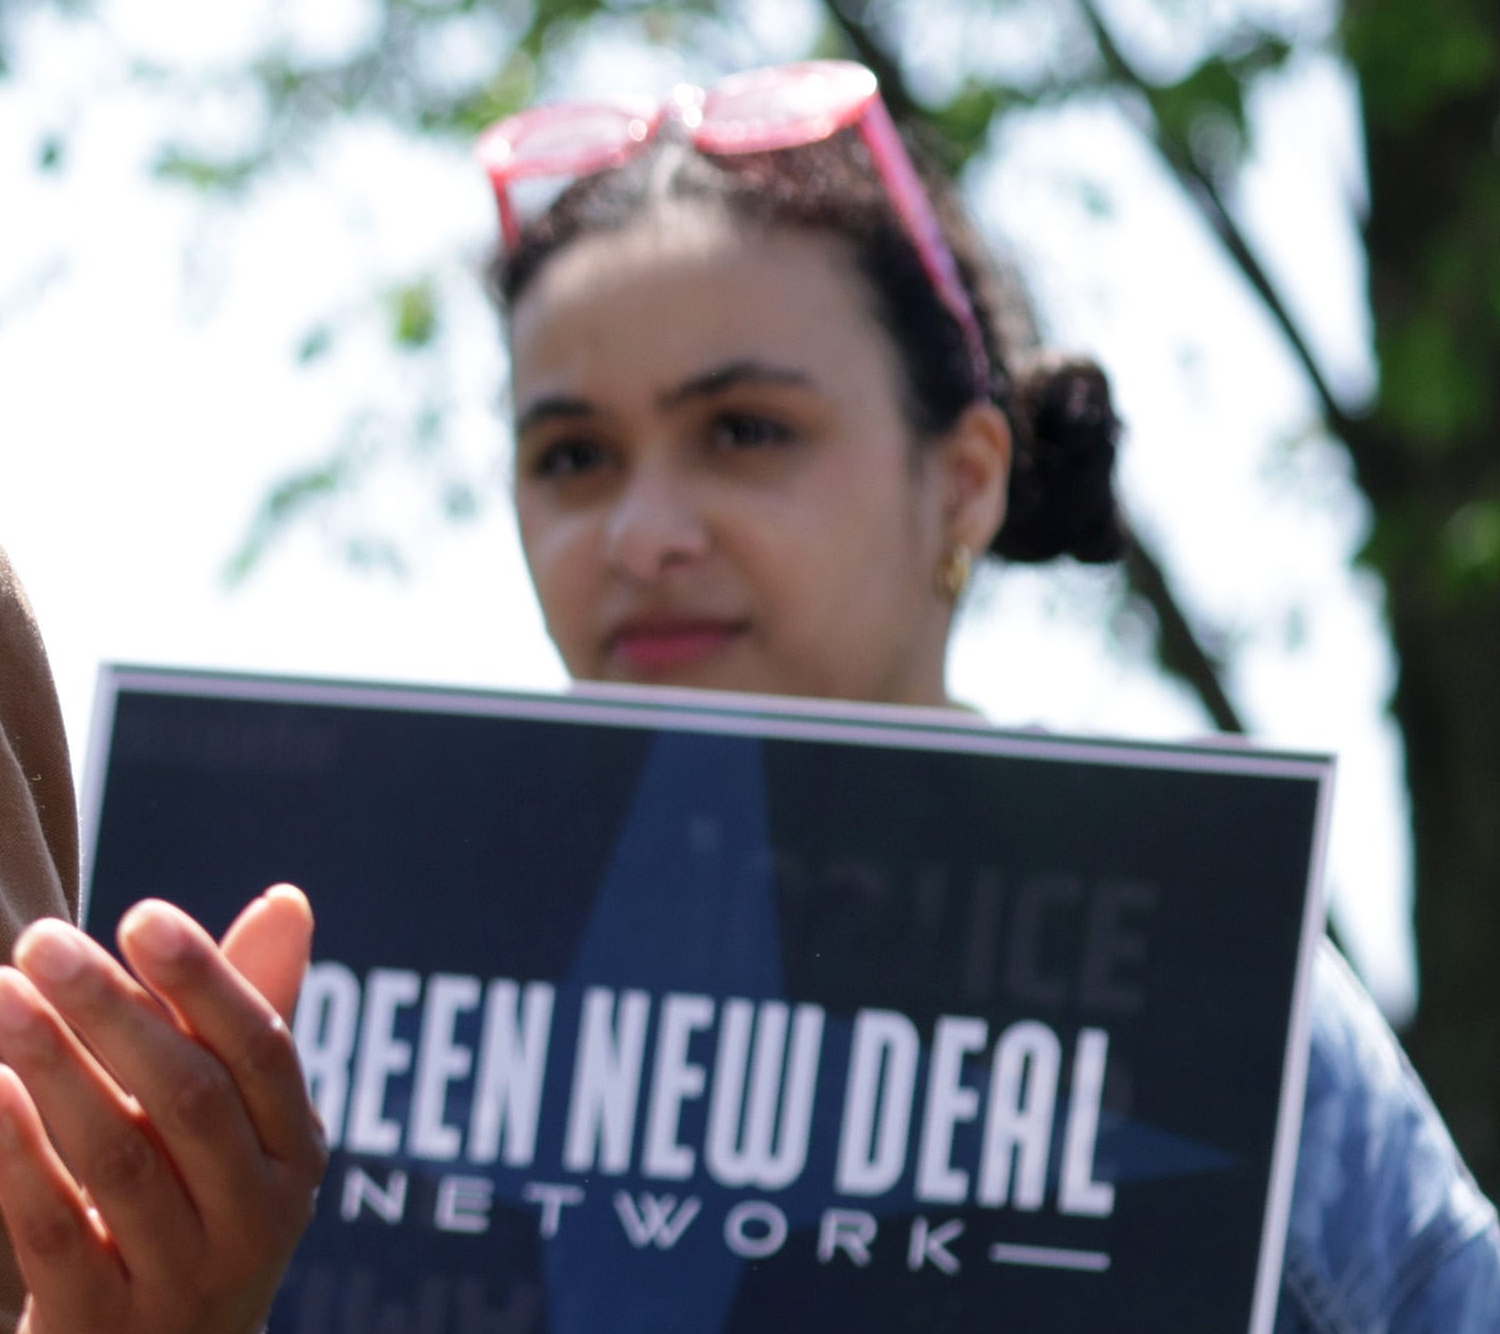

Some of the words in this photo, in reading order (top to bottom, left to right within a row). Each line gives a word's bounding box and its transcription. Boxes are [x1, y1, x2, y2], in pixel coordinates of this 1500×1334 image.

[293, 962, 556, 1167] REEN
[562, 987, 825, 1192] NEW
[836, 1009, 1116, 1216] DEAL
[341, 1167, 964, 1273] NETWORK
